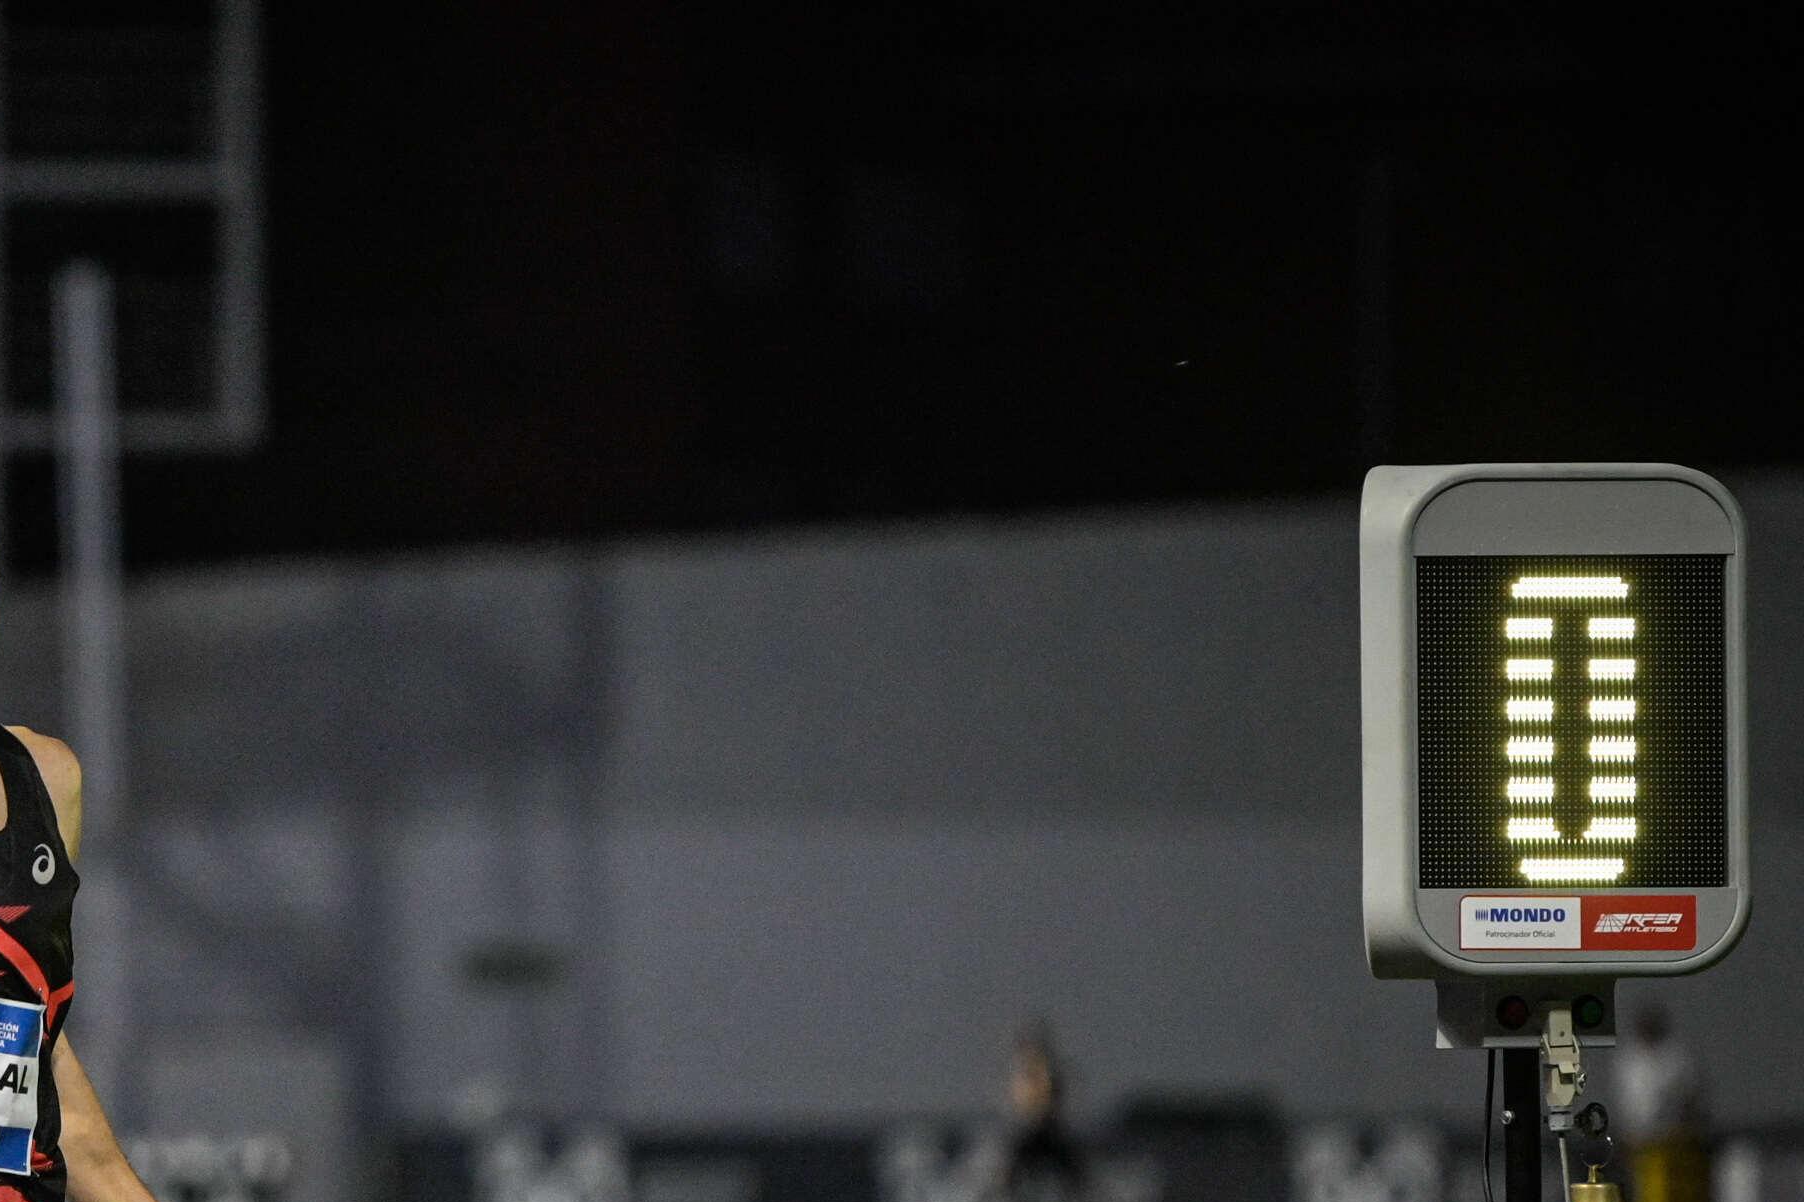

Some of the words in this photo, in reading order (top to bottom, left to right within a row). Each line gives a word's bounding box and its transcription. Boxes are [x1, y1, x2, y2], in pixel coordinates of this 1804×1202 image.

[1490, 908, 1566, 923] MONDO
[1485, 930, 1531, 938] Patrocinador
[1533, 930, 1556, 938] Oficial
